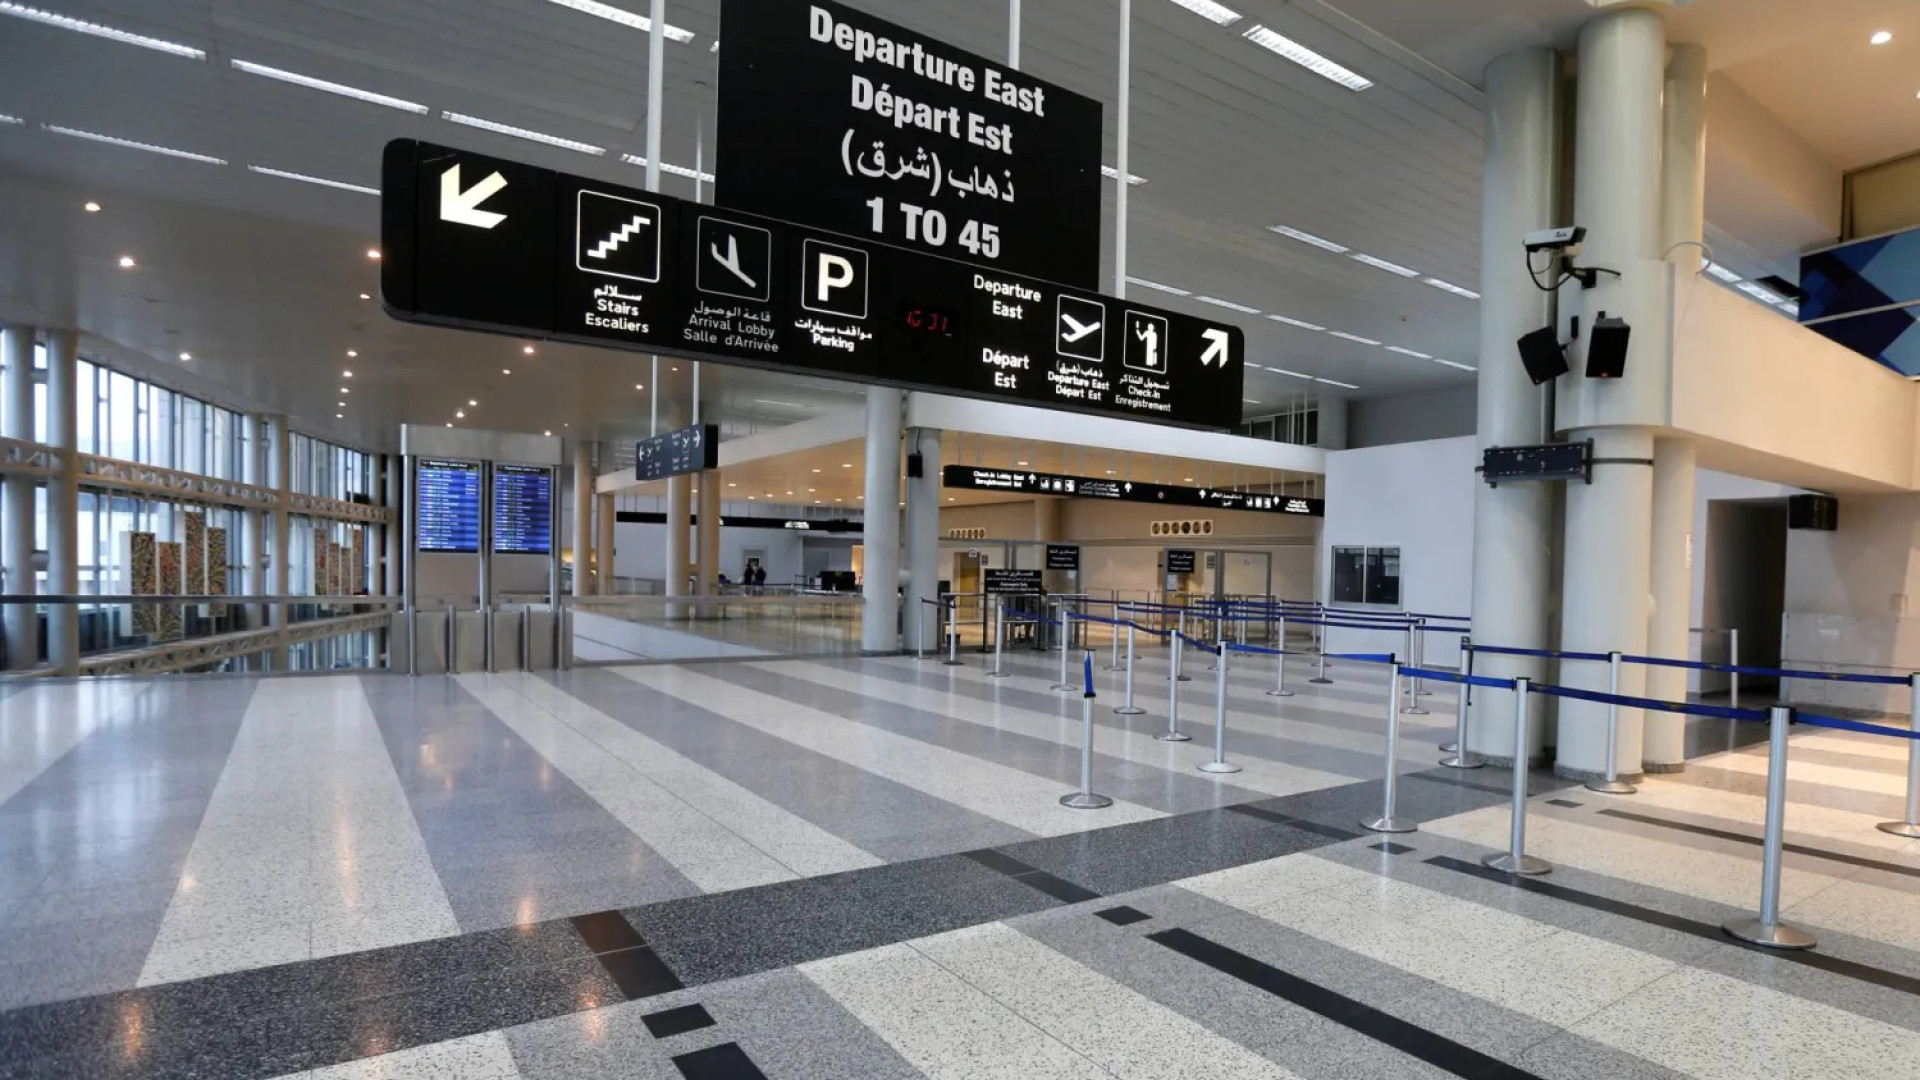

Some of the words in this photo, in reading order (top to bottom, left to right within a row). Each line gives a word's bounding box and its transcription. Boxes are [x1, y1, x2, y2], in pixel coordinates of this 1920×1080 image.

[809, 5, 975, 92] Departure
[984, 68, 1045, 117] East
[851, 75, 961, 139] Départ
[967, 112, 1013, 155] Est
[841, 129, 942, 197] (شرق)
[948, 163, 1015, 203] ذهاب
[866, 196, 884, 233] 1
[900, 202, 946, 246] TO
[958, 219, 1000, 259] 45
[817, 252, 854, 301] P
[973, 274, 1042, 302] Departure
[597, 298, 640, 316] Stairs
[694, 300, 741, 318] الوصول
[743, 308, 771, 322] قاعة
[992, 300, 1023, 320] East
[585, 312, 649, 333] Escaliers
[689, 314, 731, 331] Arrival
[738, 321, 775, 339] Lobby
[794, 318, 836, 333] سيارات
[837, 325, 873, 340] مواقف
[683, 328, 717, 343] Salle
[725, 334, 779, 353] d'Arrivée
[813, 333, 855, 352] Parking
[982, 347, 1030, 370] Départ
[994, 371, 1017, 389] Est
[1047, 371, 1089, 387] Departure
[1092, 379, 1110, 391] East
[1055, 384, 1085, 398] Départ
[1088, 390, 1102, 401] Est
[1115, 394, 1171, 412] Enregistrement
